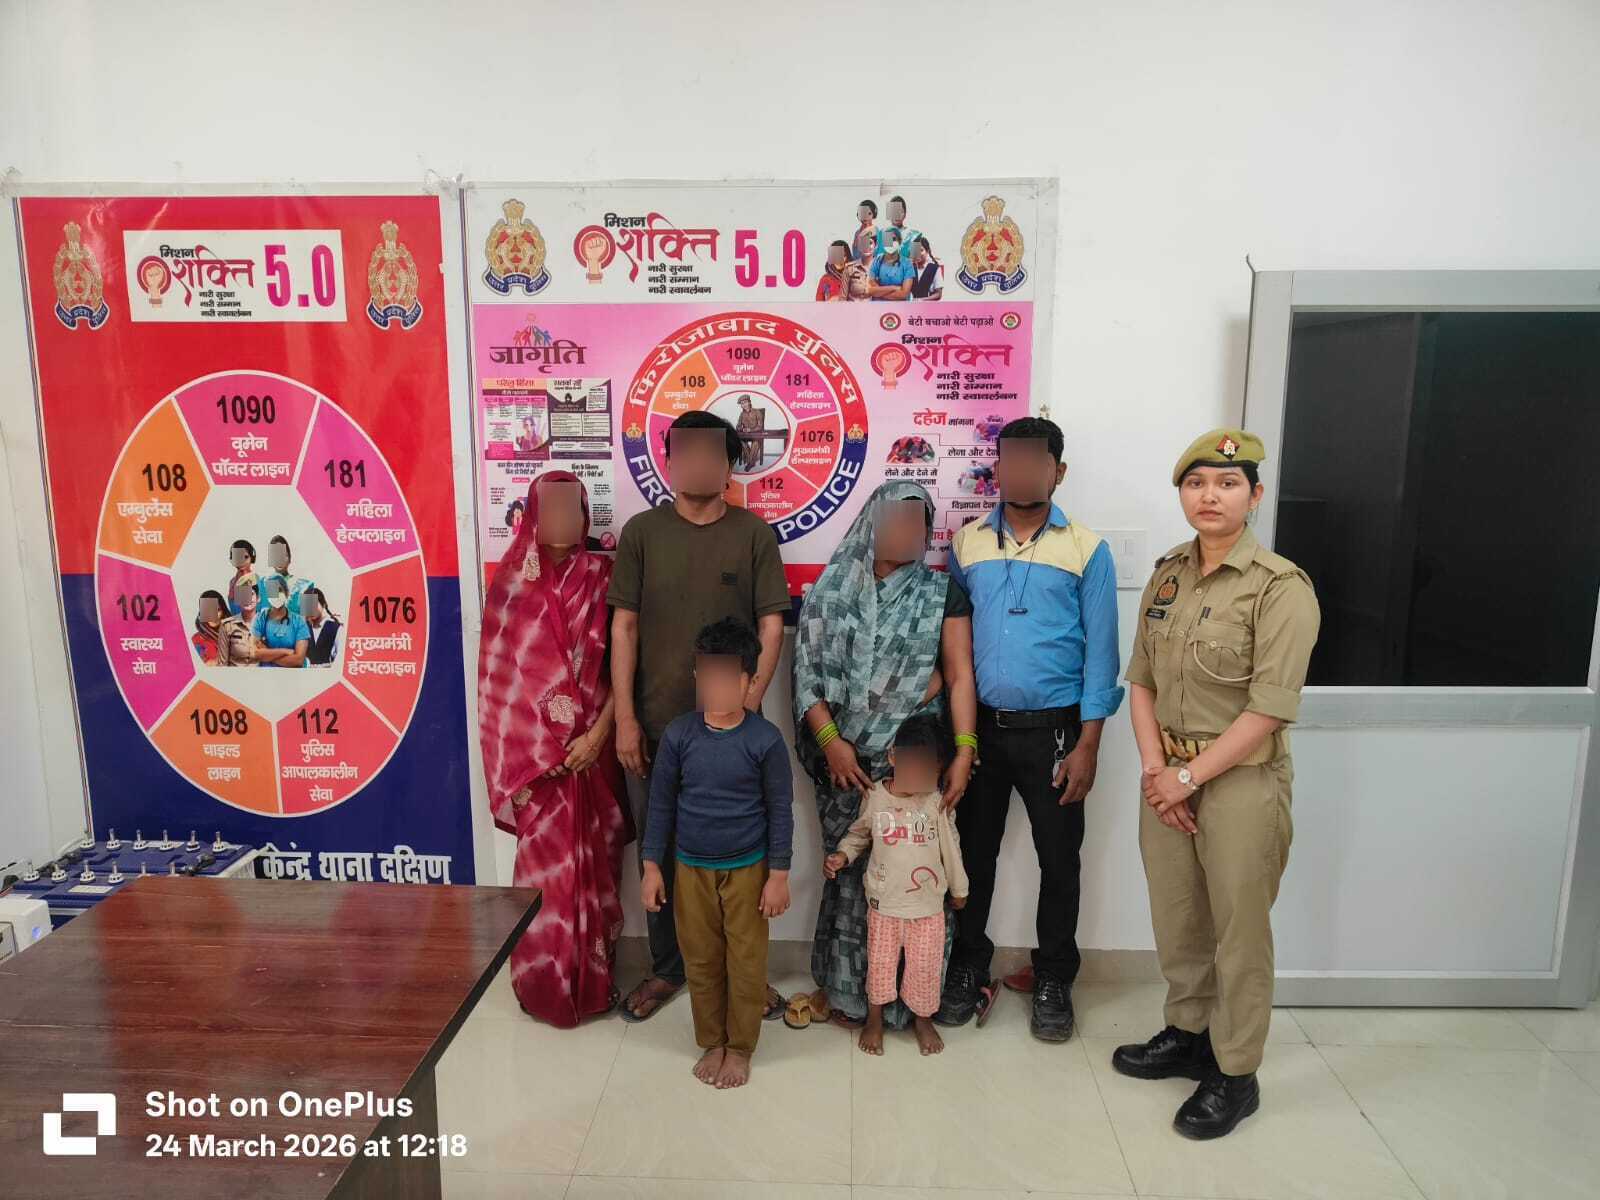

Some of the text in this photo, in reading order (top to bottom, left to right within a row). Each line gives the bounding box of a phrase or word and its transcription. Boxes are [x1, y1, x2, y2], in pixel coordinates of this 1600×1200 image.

[604, 212, 646, 228] मिशन
[159, 245, 195, 258] मिशन
[616, 212, 720, 283] शक्ति
[648, 263, 693, 275] नारी सुरक्षा
[735, 229, 806, 288] 5.0
[172, 244, 255, 307] शक्ति
[264, 244, 336, 308] 5.0
[648, 274, 666, 283] नारी
[648, 285, 666, 294] नारी
[908, 315, 923, 326] बेटी
[925, 315, 951, 326] बचाओ
[953, 315, 968, 326] बेटी
[901, 333, 942, 344] मिशन
[489, 340, 588, 374] जागृति
[727, 347, 761, 360] 1090
[912, 334, 1014, 382] शक्ति
[789, 327, 859, 405] पुलिस
[680, 375, 706, 388] 108
[785, 374, 810, 386] 181
[936, 371, 996, 383] नारी सुरक्षा
[936, 381, 960, 390] नारी
[936, 391, 960, 400] नारी
[217, 395, 276, 424] 1090
[913, 407, 947, 426] दहेज
[230, 431, 268, 458] वूमेन
[800, 431, 834, 442] 1076
[968, 446, 984, 457] और
[142, 463, 188, 492] 108
[211, 457, 290, 478] पॉवर लाइन
[324, 460, 366, 488] 181
[759, 479, 784, 490] 112
[346, 498, 393, 519] महिला
[776, 457, 861, 541] POLICE
[131, 525, 164, 545] सेवा
[335, 525, 407, 546] हेल्पलाइन
[116, 594, 162, 622] 102
[359, 596, 417, 624] 1076
[349, 632, 413, 657] मुख्यमंत्री
[132, 656, 157, 675] सेवा
[347, 655, 417, 677] हेल्पलाइन
[190, 708, 248, 735] 1098
[297, 708, 339, 735] 112
[203, 743, 241, 759] चाइल्ड
[300, 738, 335, 763] पुलिस
[207, 766, 241, 781] लाइन
[308, 784, 333, 802] सेवा
[319, 852, 374, 882] थाना
[376, 845, 452, 885] दक्षिण
